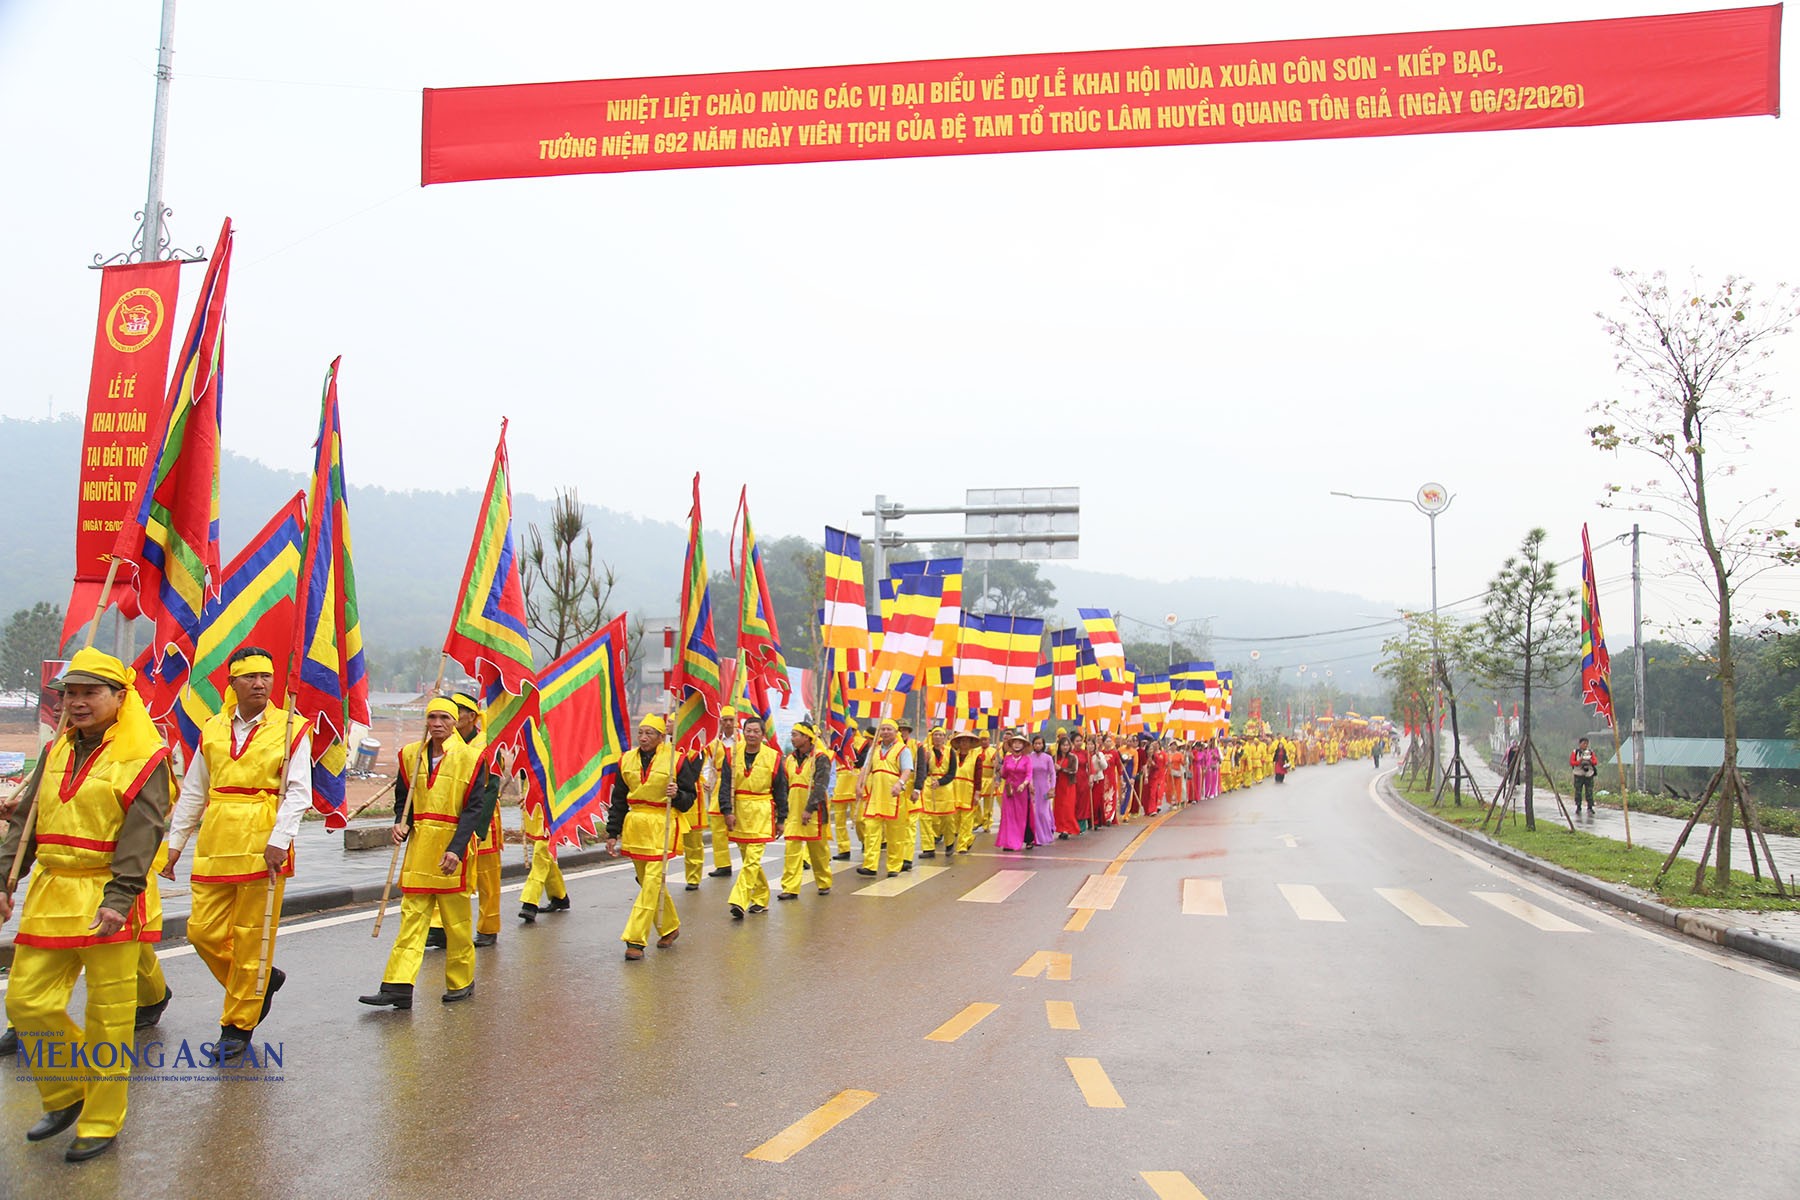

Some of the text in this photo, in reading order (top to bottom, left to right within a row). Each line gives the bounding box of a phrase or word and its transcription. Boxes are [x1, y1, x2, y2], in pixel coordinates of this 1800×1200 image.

[606, 93, 660, 125] NHIỆT
[663, 91, 702, 123] LIỆT
[705, 88, 757, 117] CHÀO
[760, 85, 819, 113] MỪNG
[823, 82, 863, 110] CÁC
[867, 84, 887, 111] VỊ
[890, 82, 925, 110] ĐẠI
[930, 71, 976, 104] BIỂU
[980, 71, 1005, 101] VỀ
[1010, 73, 1041, 103] DỰ
[1043, 67, 1067, 98] LỄ
[1072, 71, 1121, 96] KHAI
[1125, 65, 1161, 97] HỘI
[1166, 63, 1215, 91] MÙA
[1219, 58, 1277, 88] XUÂN
[1282, 55, 1327, 85] CÔN
[1332, 55, 1377, 82] SƠN
[1397, 45, 1447, 78] KIẾP
[1452, 48, 1504, 79] BẠC,
[538, 83, 1585, 160] TƯỞNG NIỆM 692 NĂM NGÀY VIÊN TỊCH CỦA ĐỆ TAM TỔ TRÚC LÂM HUYỀN QUANG TÔN GIẢ (NGÀY 06/3/2026)
[107, 371, 138, 399] LỄ TẾ
[91, 407, 147, 433] KHAI XUÂN
[86, 440, 149, 472] TẠI ĐỀN THỜ
[82, 473, 121, 502] NGUYỄN
[82, 517, 103, 532] (NGÀY
